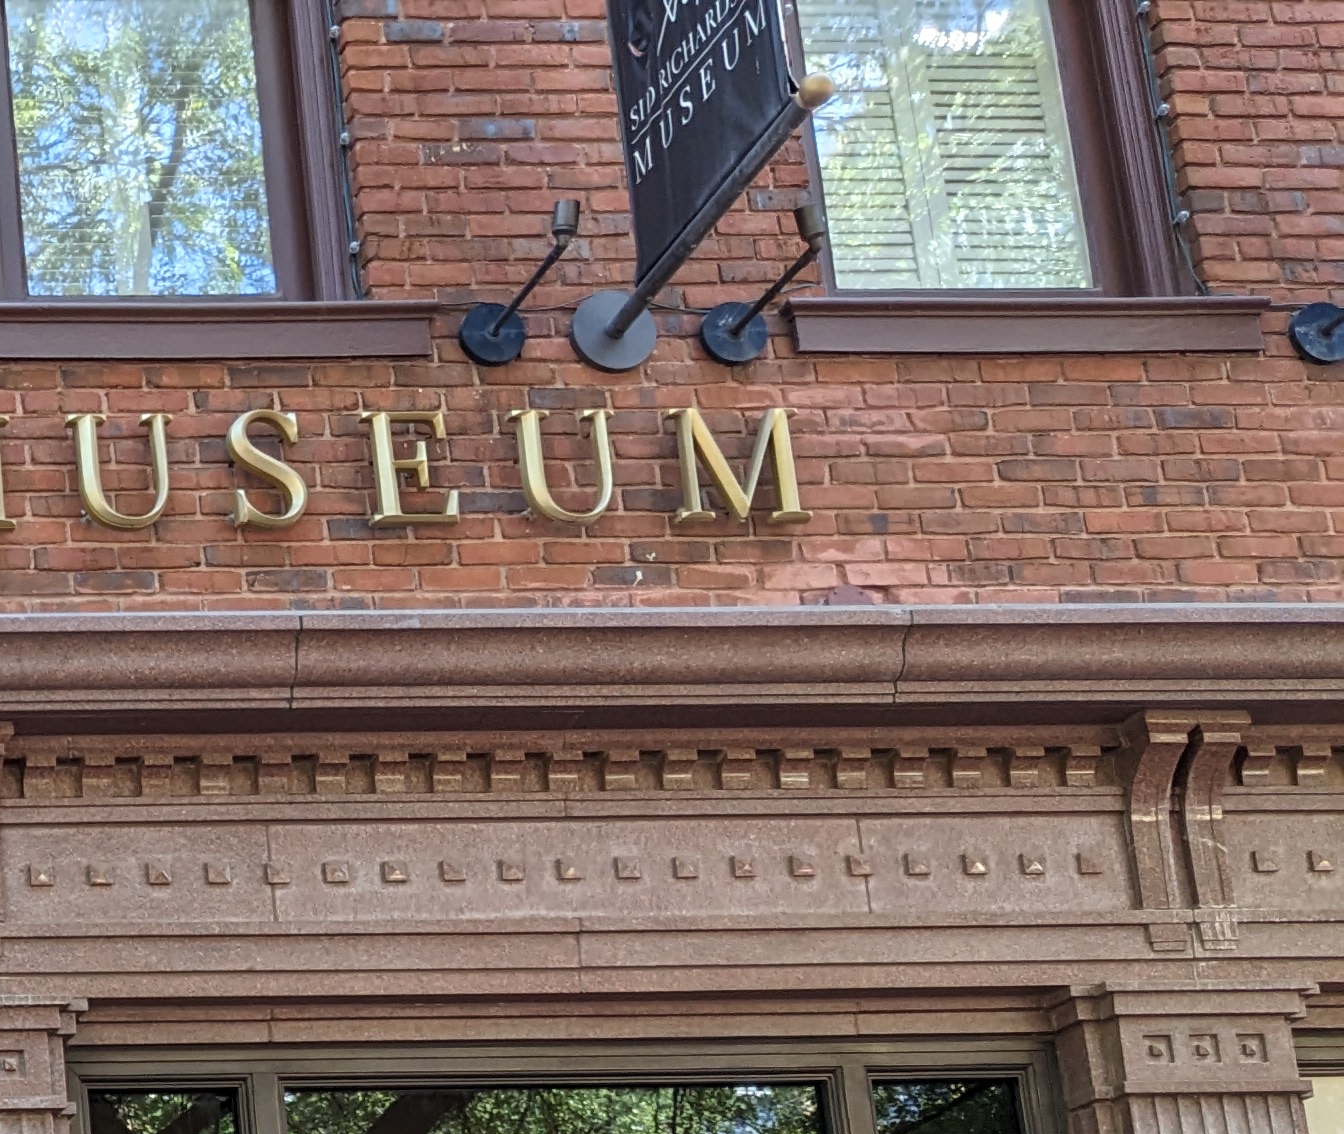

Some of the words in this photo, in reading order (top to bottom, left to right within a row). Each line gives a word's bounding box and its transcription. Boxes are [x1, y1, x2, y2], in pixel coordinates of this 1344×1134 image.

[630, 87, 656, 131] SID
[658, 0, 738, 94] RICHARD
[633, 0, 767, 185] MUSEUM
